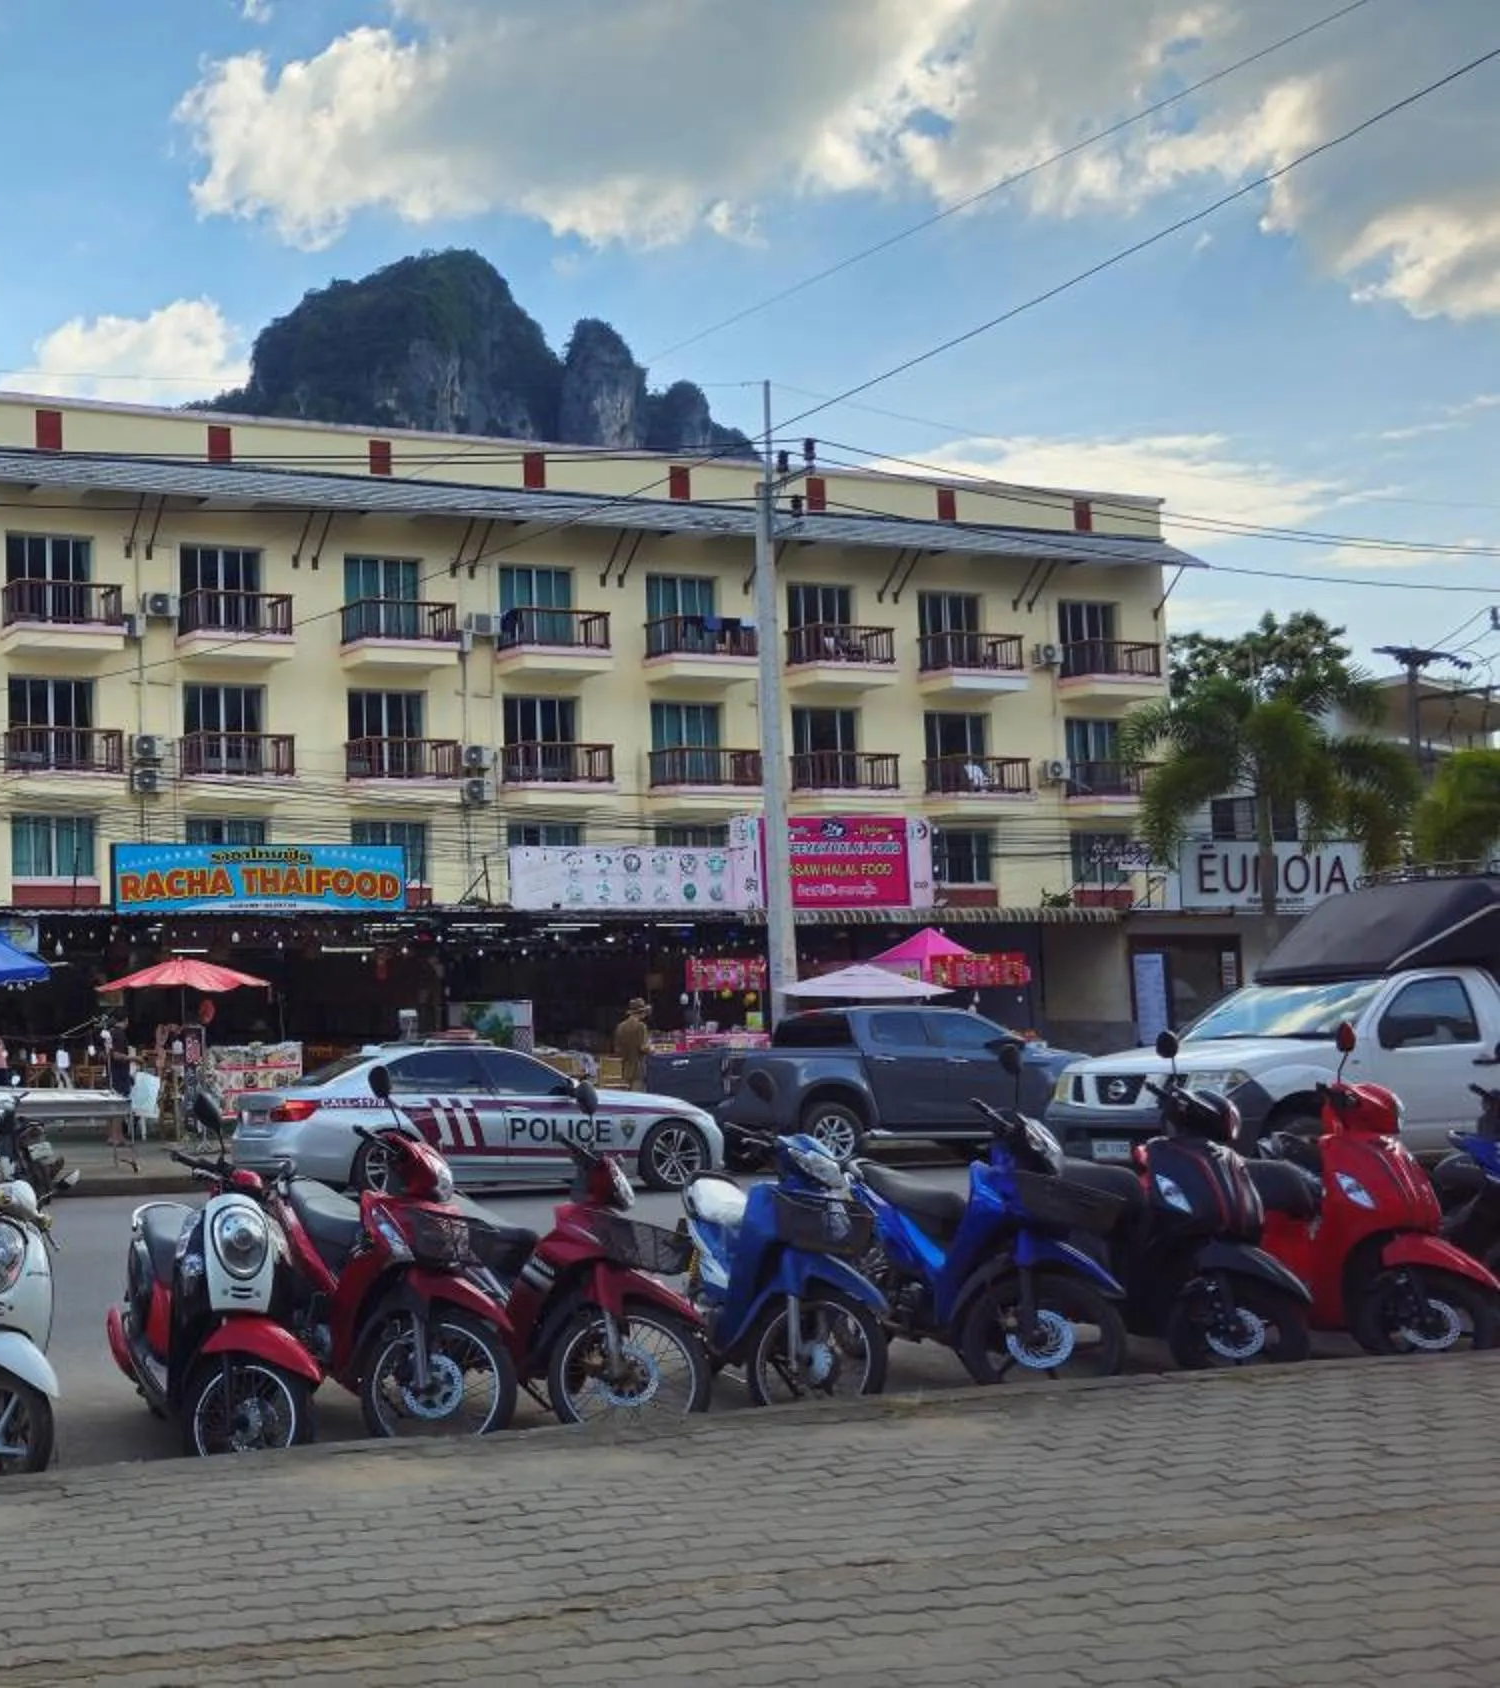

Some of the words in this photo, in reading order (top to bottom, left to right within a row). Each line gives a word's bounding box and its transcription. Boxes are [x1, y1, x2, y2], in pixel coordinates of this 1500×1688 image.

[861, 863, 893, 876] FOOD
[119, 869, 235, 902] RACHA
[241, 867, 400, 900] THAIFOOD
[509, 1117, 612, 1144] POLICE
